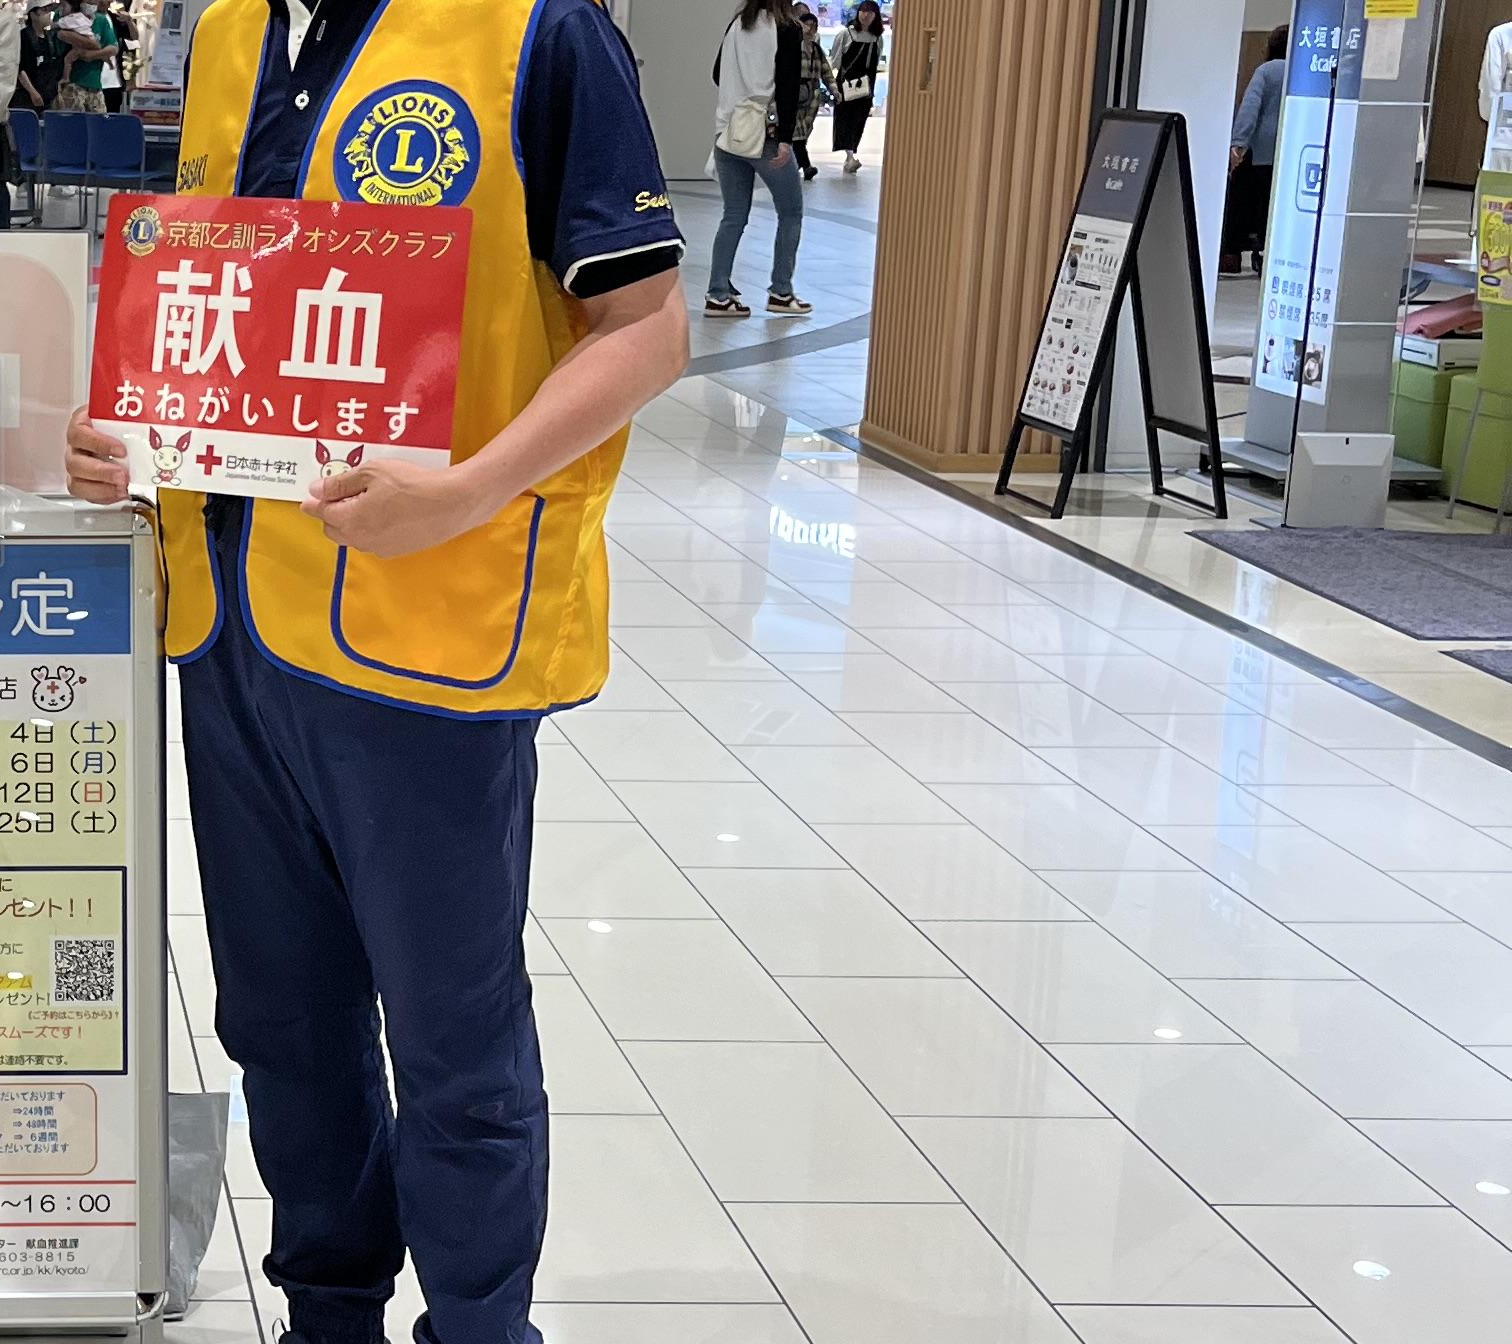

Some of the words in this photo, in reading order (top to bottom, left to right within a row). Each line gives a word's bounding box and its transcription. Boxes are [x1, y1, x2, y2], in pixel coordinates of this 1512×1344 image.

[378, 96, 449, 124] LIONS
[390, 129, 424, 173] L
[365, 182, 437, 205] INTERNATIONAL
[151, 259, 387, 384] 献血
[114, 378, 419, 441] おねがいします
[226, 455, 298, 475] 日本赤十字社
